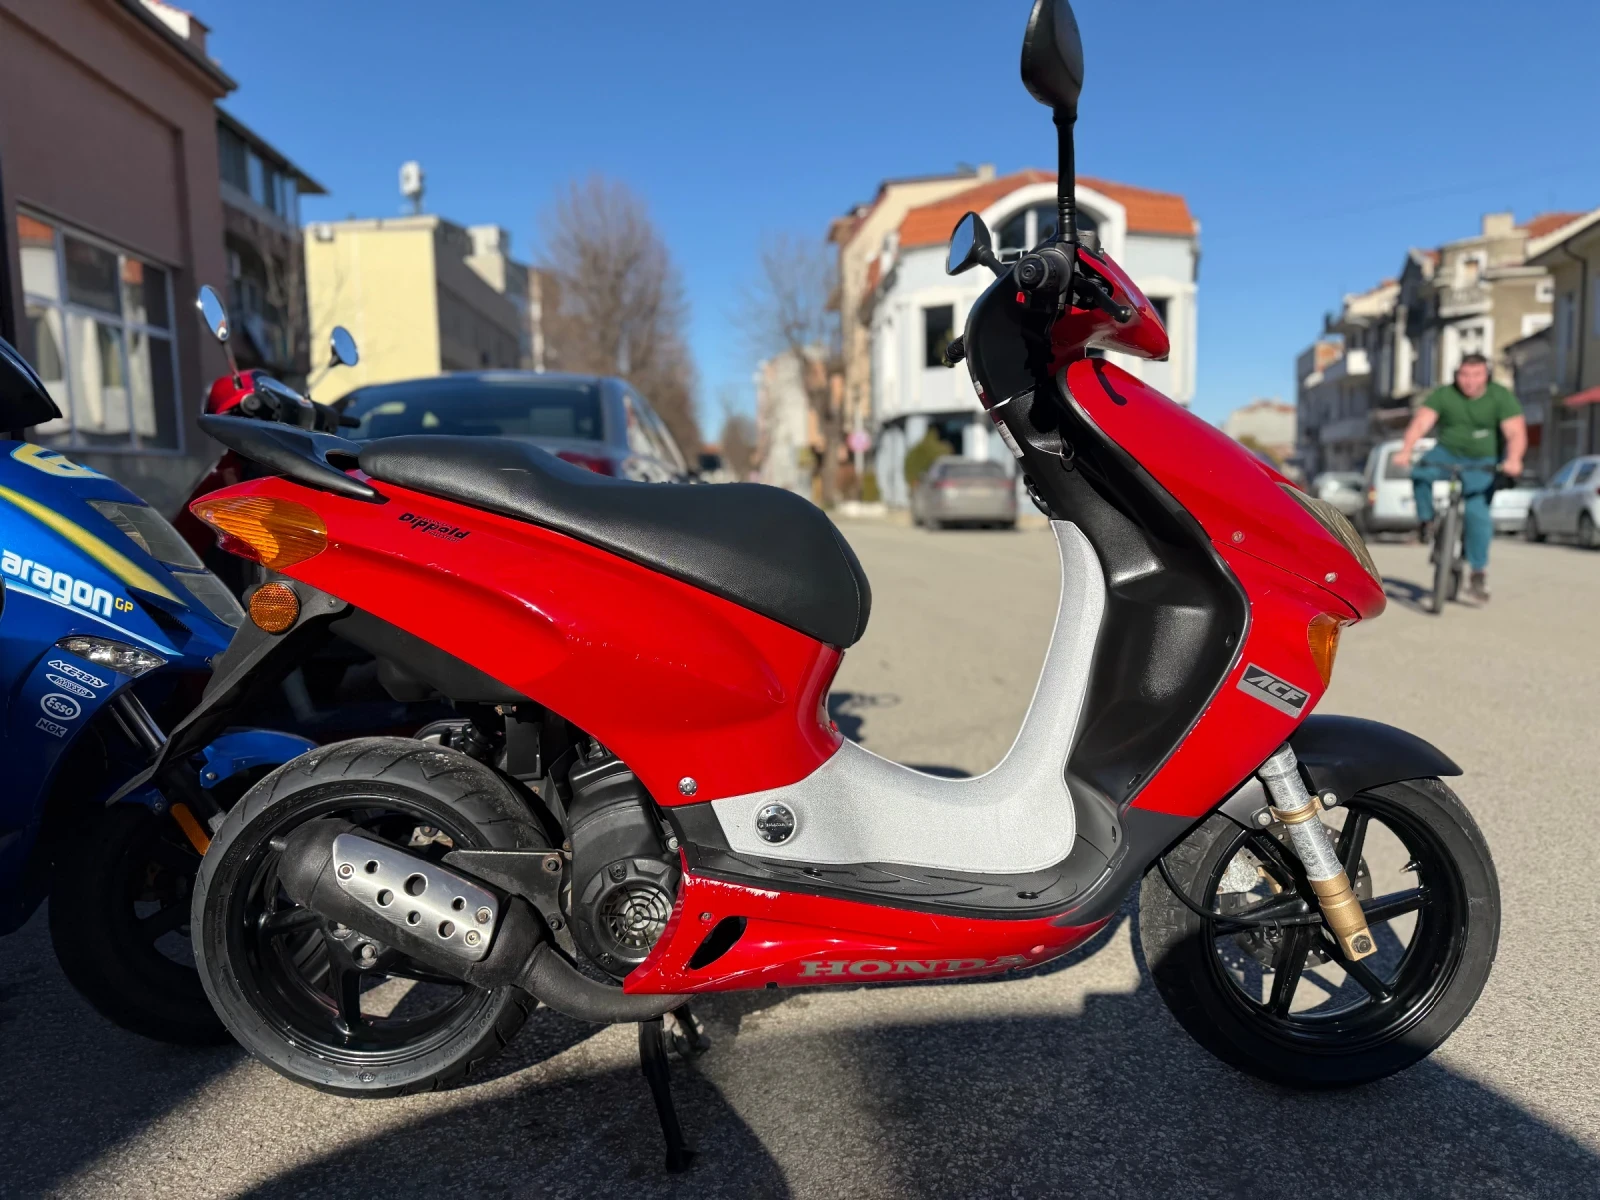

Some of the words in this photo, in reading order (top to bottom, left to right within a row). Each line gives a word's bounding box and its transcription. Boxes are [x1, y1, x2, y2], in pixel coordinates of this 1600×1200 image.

[398, 512, 471, 539] Dippold
[1, 549, 115, 619] aragon
[114, 597, 134, 612] GP
[54, 676, 89, 697] MAXXIS
[1245, 675, 1307, 701] ACF
[37, 719, 66, 736] NGK
[797, 953, 1032, 977] HONDA
